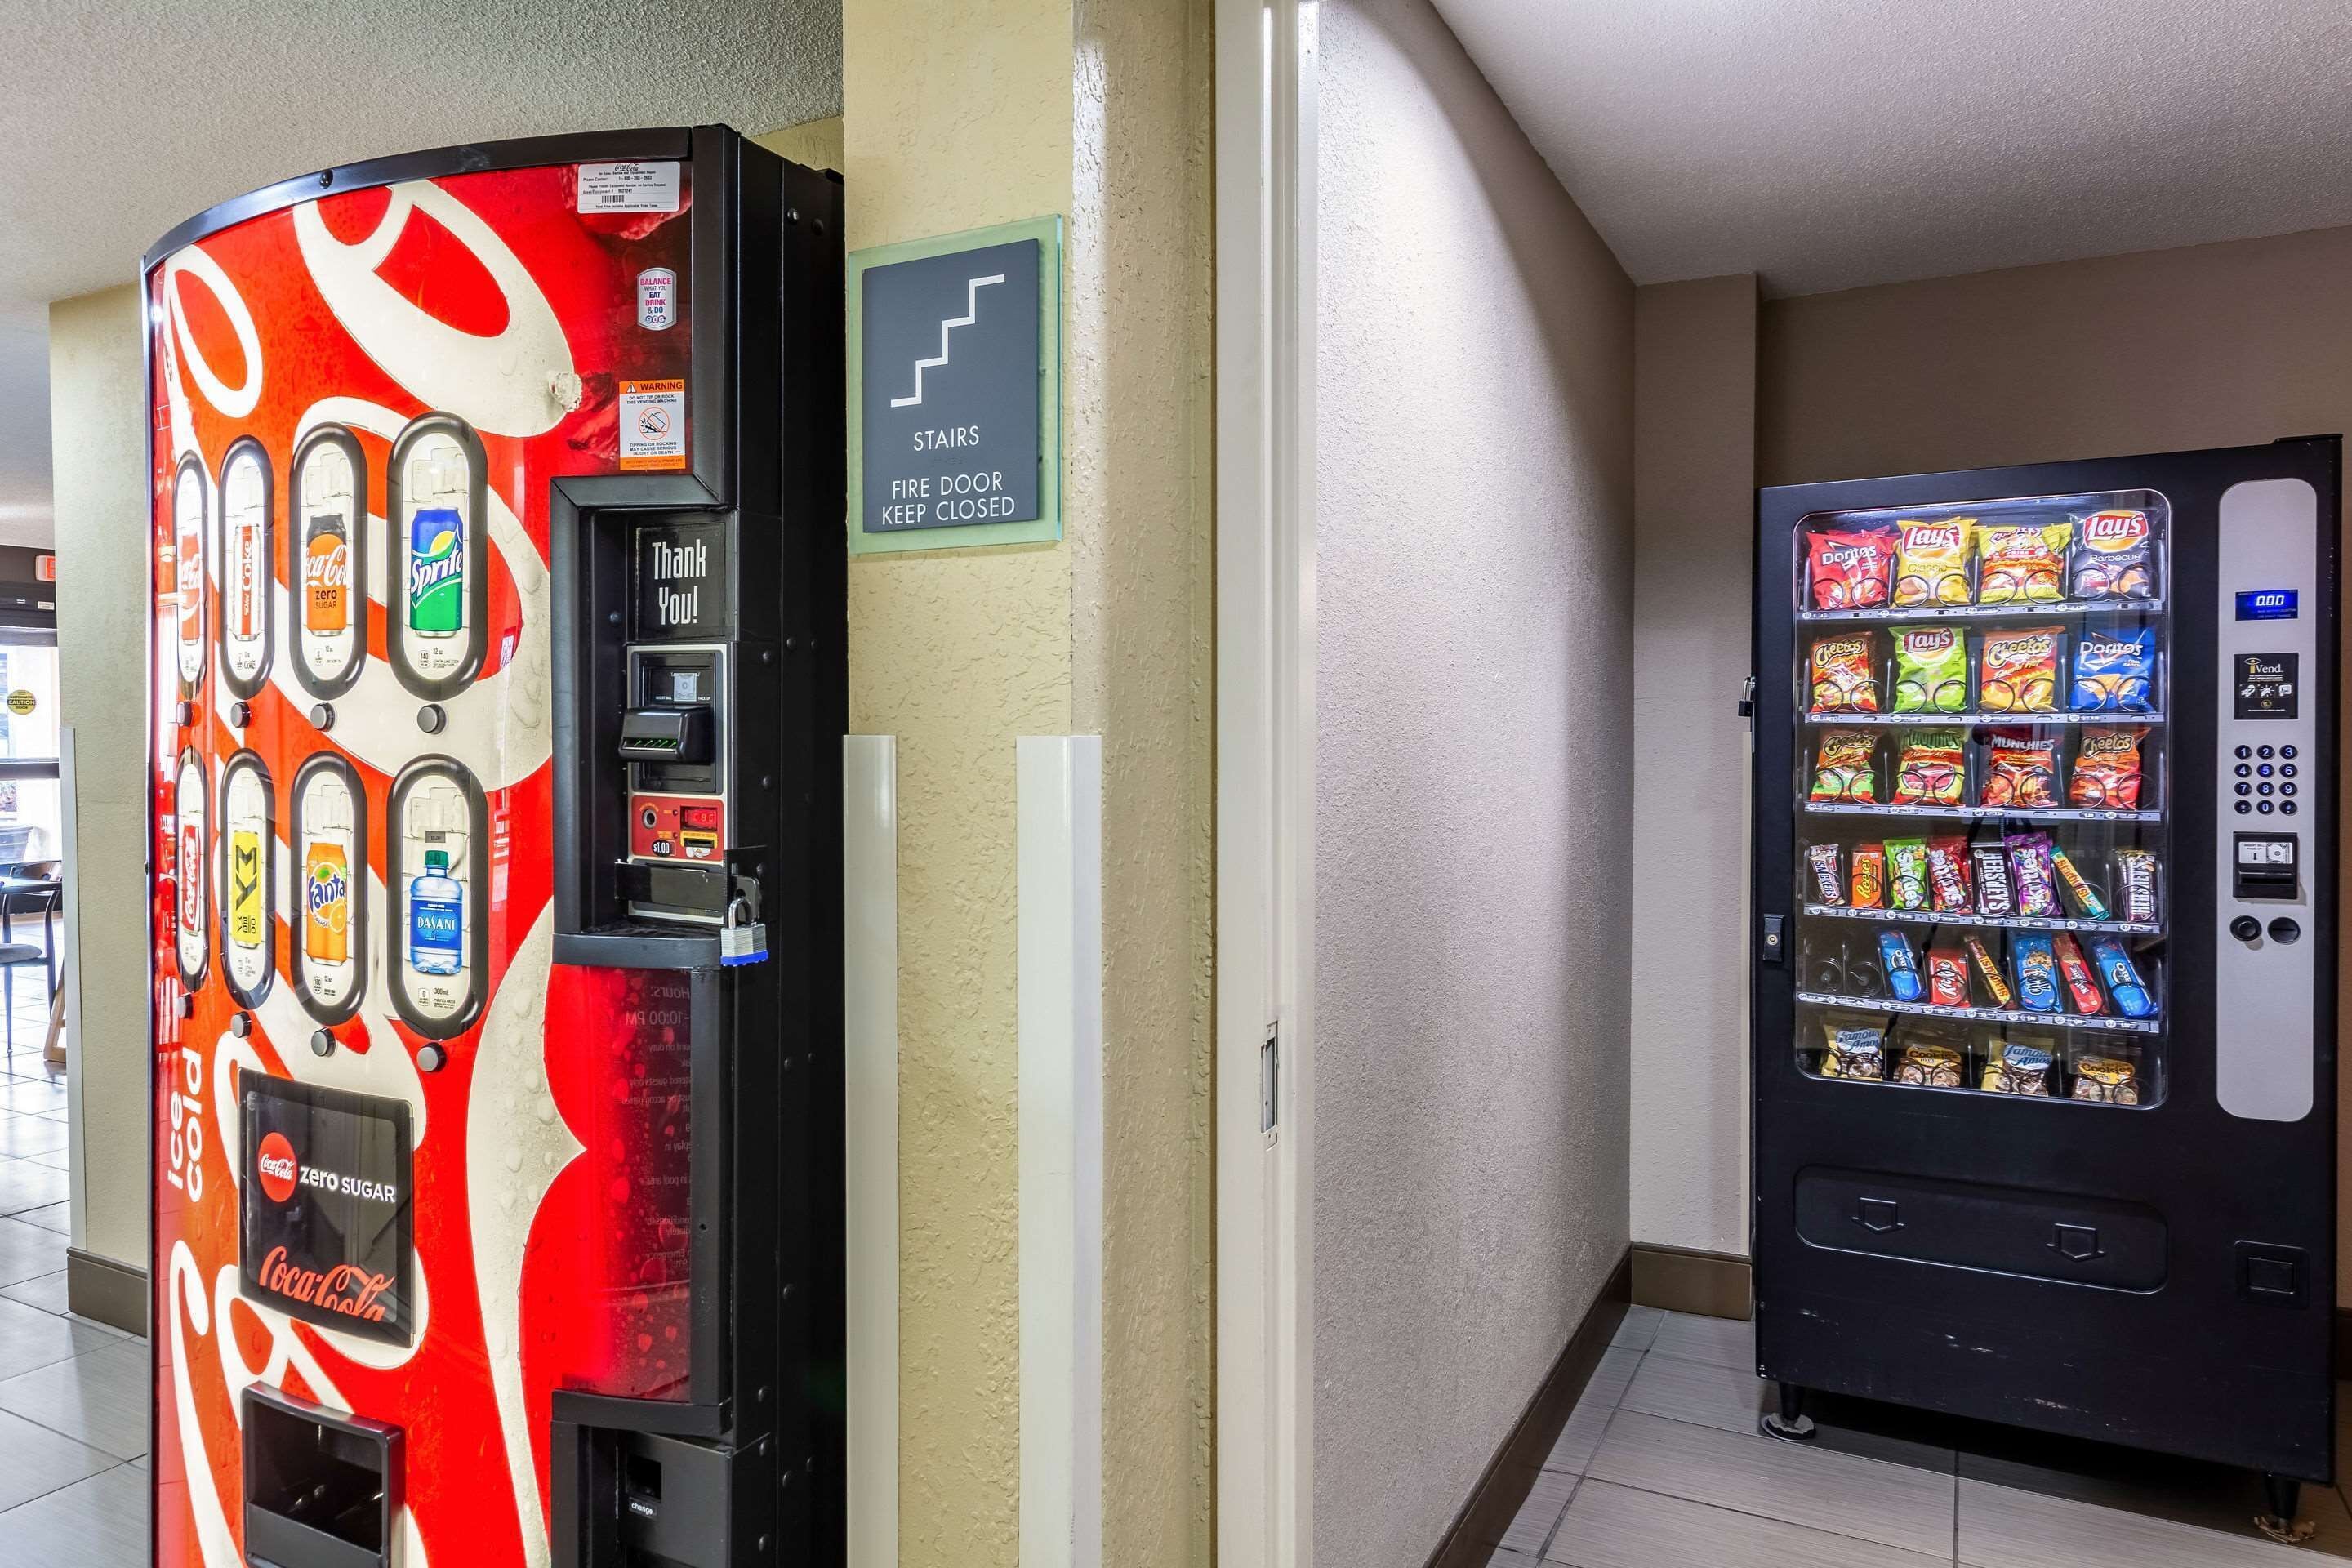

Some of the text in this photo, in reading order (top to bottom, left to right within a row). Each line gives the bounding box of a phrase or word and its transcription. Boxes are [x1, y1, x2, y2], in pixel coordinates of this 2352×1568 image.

[640, 381, 683, 390] WARNING
[913, 425, 979, 452] STAIRS
[892, 471, 1003, 501] FIRE DOOR
[882, 497, 1015, 525] KEEP CLOSED
[652, 539, 706, 580] Thank
[1822, 546, 1876, 566] Doritos
[2091, 554, 2141, 562] Barbecue
[242, 540, 252, 592] Coke
[410, 542, 463, 598] Sprite
[1908, 564, 1948, 573] Classic
[315, 590, 337, 600] zero
[315, 600, 337, 609] SUGAR
[658, 586, 698, 626] You!
[1815, 640, 1863, 666] Cheetos
[1989, 636, 2051, 667] Cheetos
[2080, 641, 2144, 656] Doritos
[1824, 734, 1874, 755] Cheetos
[1991, 734, 2056, 751] MUNCHIES
[2083, 735, 2132, 757] Cheetos
[2241, 748, 2247, 756] 1
[2262, 748, 2270, 756] 2
[2285, 747, 2293, 756] 3
[2239, 767, 2247, 775] 4
[2262, 767, 2270, 775] 5
[2285, 766, 2292, 775] 6
[2240, 785, 2247, 793] 7
[2262, 785, 2270, 793] 8
[2285, 785, 2292, 794] 9
[2262, 804, 2269, 812] 0
[653, 841, 670, 854] $1.00
[1815, 862, 1837, 897] SNICKERS
[308, 873, 345, 914] Fanta
[417, 916, 455, 932] DASANI
[1909, 1050, 1958, 1060] Cookies
[2082, 1063, 2133, 1075] Cookies
[167, 1047, 203, 1203] ice cold
[259, 1153, 296, 1181] Coca-Cola
[299, 1165, 396, 1202] zero SUGAR
[258, 1245, 395, 1322] Coca-Cola
[631, 1502, 653, 1515] change
